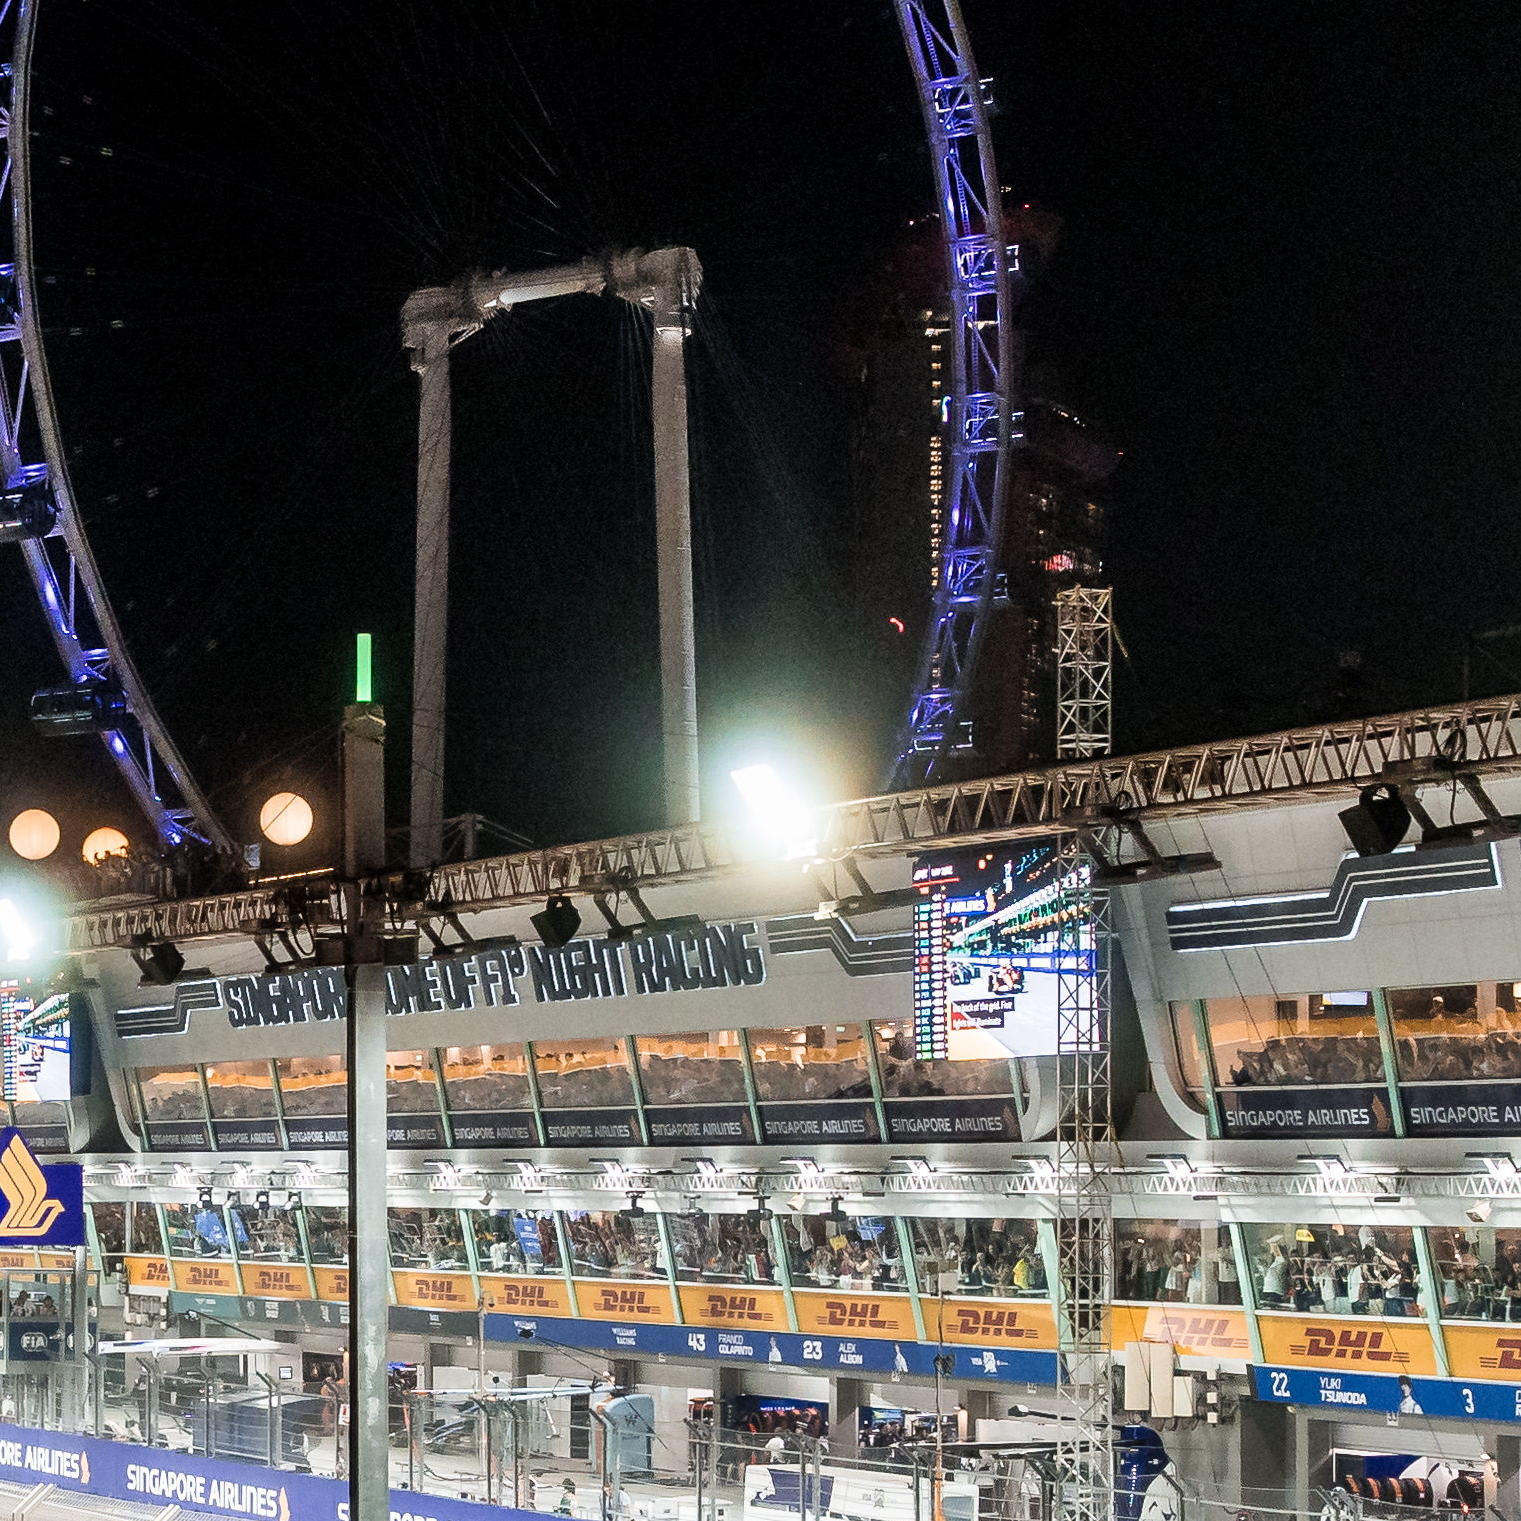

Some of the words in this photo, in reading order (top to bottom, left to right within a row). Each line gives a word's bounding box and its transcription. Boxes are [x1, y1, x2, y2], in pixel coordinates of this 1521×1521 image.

[224, 966, 347, 1029] SINGAPOR
[385, 959, 445, 1016] OME
[530, 938, 630, 1004] NIGHT
[631, 920, 767, 995] RACING
[891, 1117, 952, 1133] SINGAPORE
[954, 1116, 1003, 1132] AIRLINES
[1226, 1109, 1304, 1127] SINGAPORE
[1307, 1107, 1370, 1125] AIRLINES
[1410, 1105, 1499, 1125] SINGAPORE
[325, 1131, 348, 1143] AIRLINE
[548, 1126, 593, 1138] SINGAPORE
[594, 1125, 630, 1138] AIRLINES
[651, 1123, 701, 1137] SINGAPORE
[702, 1121, 742, 1136] AIRLINES
[765, 1120, 820, 1135] SINGAPORE
[822, 1120, 866, 1134] AIRLINES
[190, 1266, 223, 1286] DHL
[259, 1270, 296, 1290] DHL
[415, 1279, 458, 1300] DHL
[504, 1284, 550, 1307] DHL
[601, 1289, 652, 1313] DHL
[707, 1295, 762, 1319] DHL
[825, 1302, 886, 1328] DHL
[957, 1309, 1025, 1337] DHL
[22, 1335, 46, 1348] FIA
[687, 1332, 706, 1351] 43
[718, 1334, 744, 1345] FRANCO
[1159, 1316, 1233, 1348] DHL
[718, 1344, 754, 1357] COLAPINTO
[803, 1339, 823, 1360] 23
[838, 1343, 857, 1354] ALEX
[1304, 1327, 1393, 1362] DHL
[839, 1353, 863, 1365] ALBON
[1271, 1371, 1291, 1397] 22
[1319, 1376, 1341, 1390] YUKI
[1320, 1389, 1367, 1405] TSUNODA
[1462, 1388, 1475, 1414] 3
[23, 1445, 80, 1479] AIRLINES
[127, 1464, 206, 1505] SINGAPORE
[208, 1478, 278, 1518] AIRLINES
